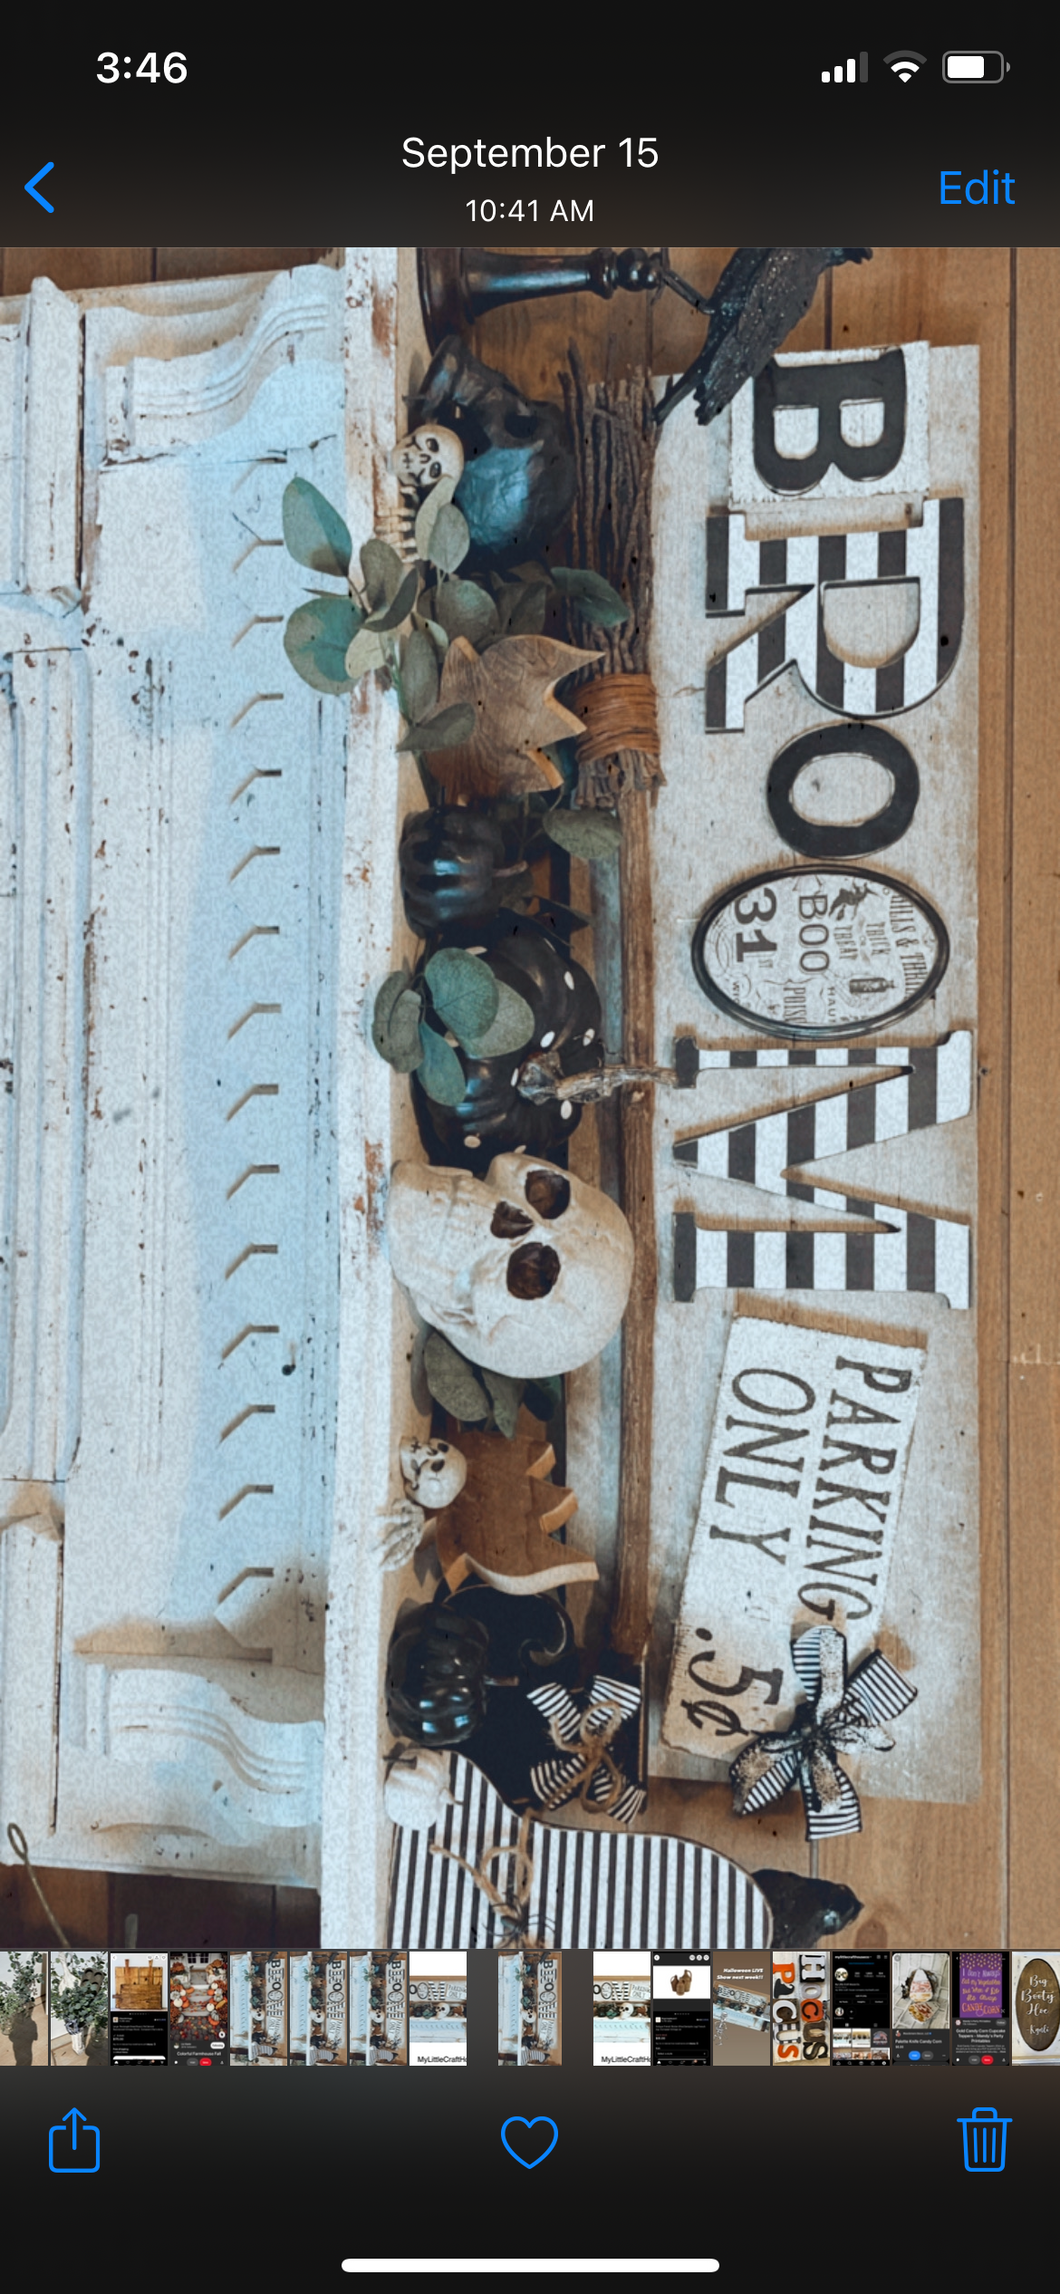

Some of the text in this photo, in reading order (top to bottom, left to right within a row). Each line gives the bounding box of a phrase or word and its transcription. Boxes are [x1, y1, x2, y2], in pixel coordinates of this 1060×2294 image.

[97, 52, 187, 83] 3:46
[403, 137, 658, 174] September 15
[941, 169, 1015, 204] Edit
[466, 199, 593, 222] 10:41 AM
[798, 894, 830, 973] BOO
[833, 923, 859, 960] TREAT
[865, 921, 891, 956] TRICK
[709, 1367, 816, 1566] ONLY
[797, 1355, 912, 1620] PARKING
[1021, 1988, 1055, 2004] Booty
[1029, 1974, 1048, 1987] Big
[799, 1954, 829, 2060] HOCUS
